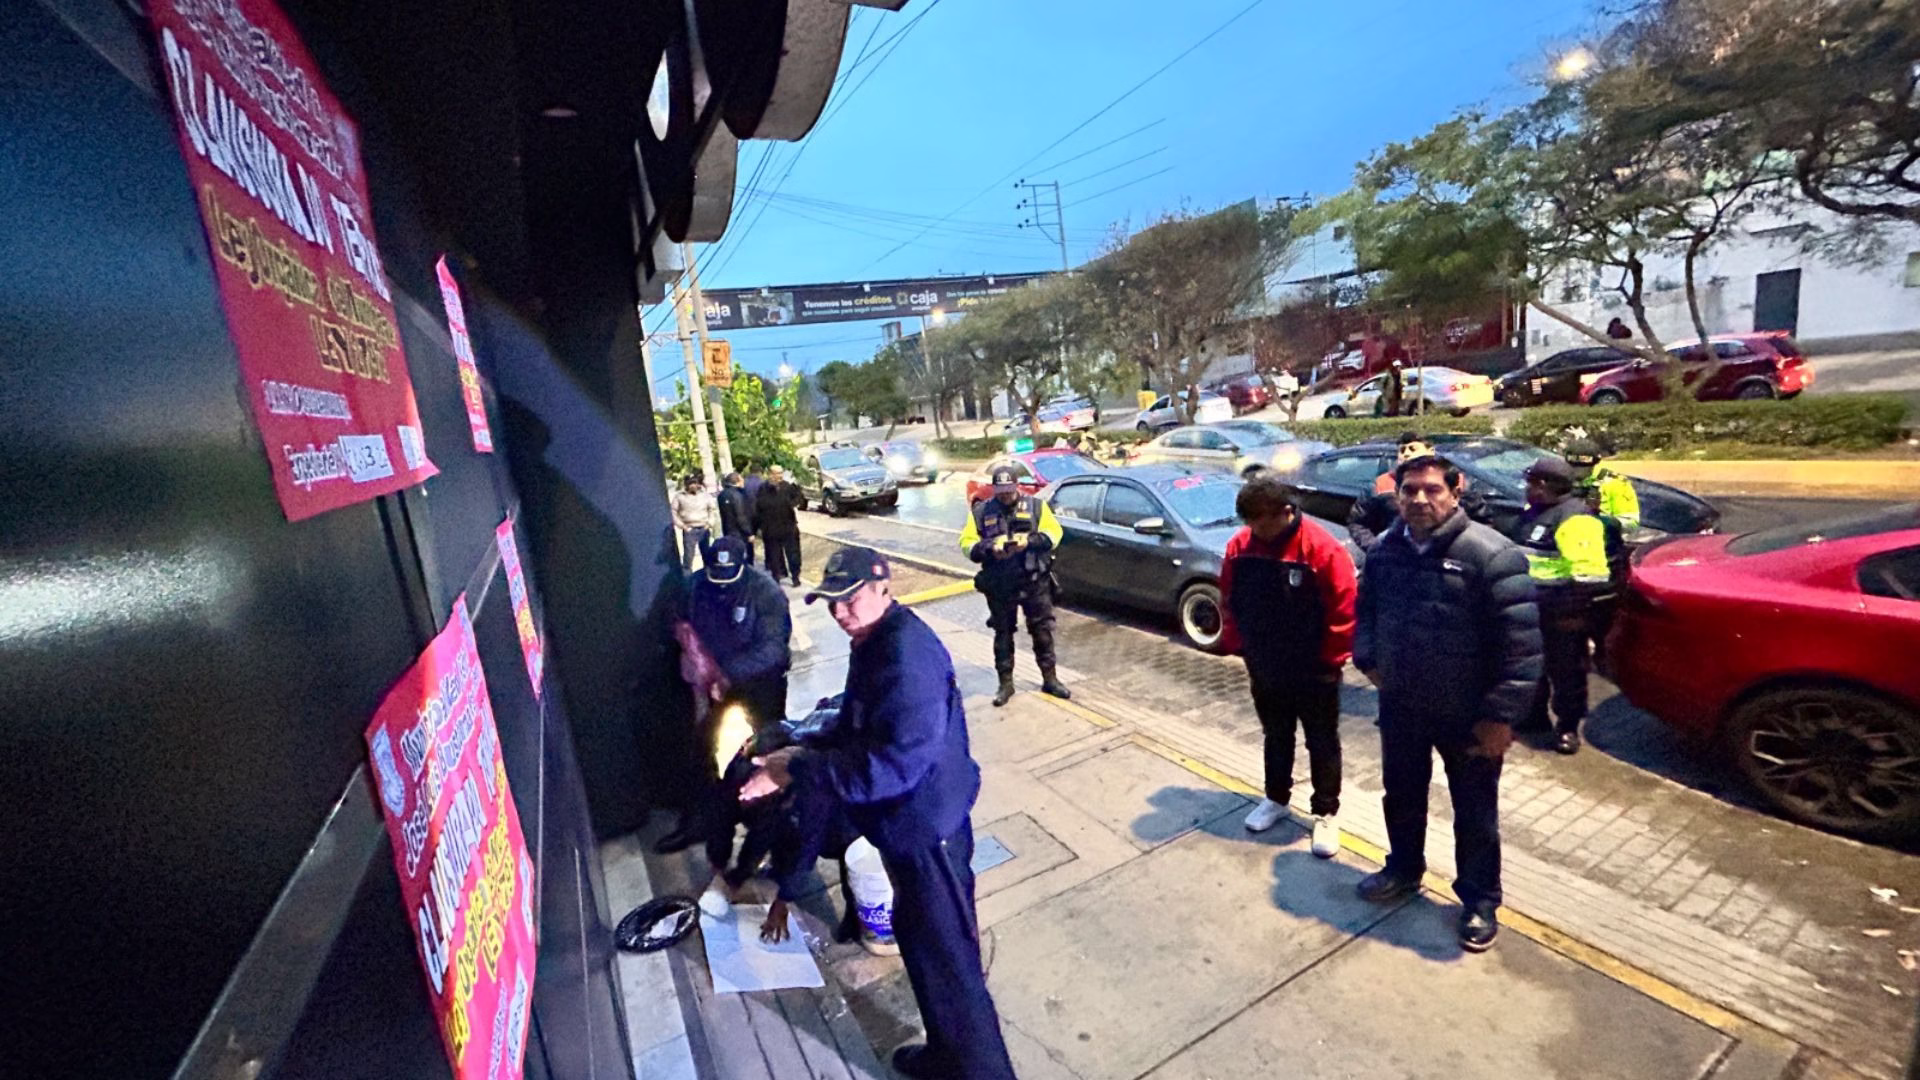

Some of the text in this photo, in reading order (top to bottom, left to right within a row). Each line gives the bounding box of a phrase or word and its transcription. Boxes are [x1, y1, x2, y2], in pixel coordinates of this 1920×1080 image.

[803, 295, 893, 309] Tenemos los créditos
[909, 290, 938, 307] caja
[704, 301, 731, 320] aja
[402, 779, 429, 879] José
